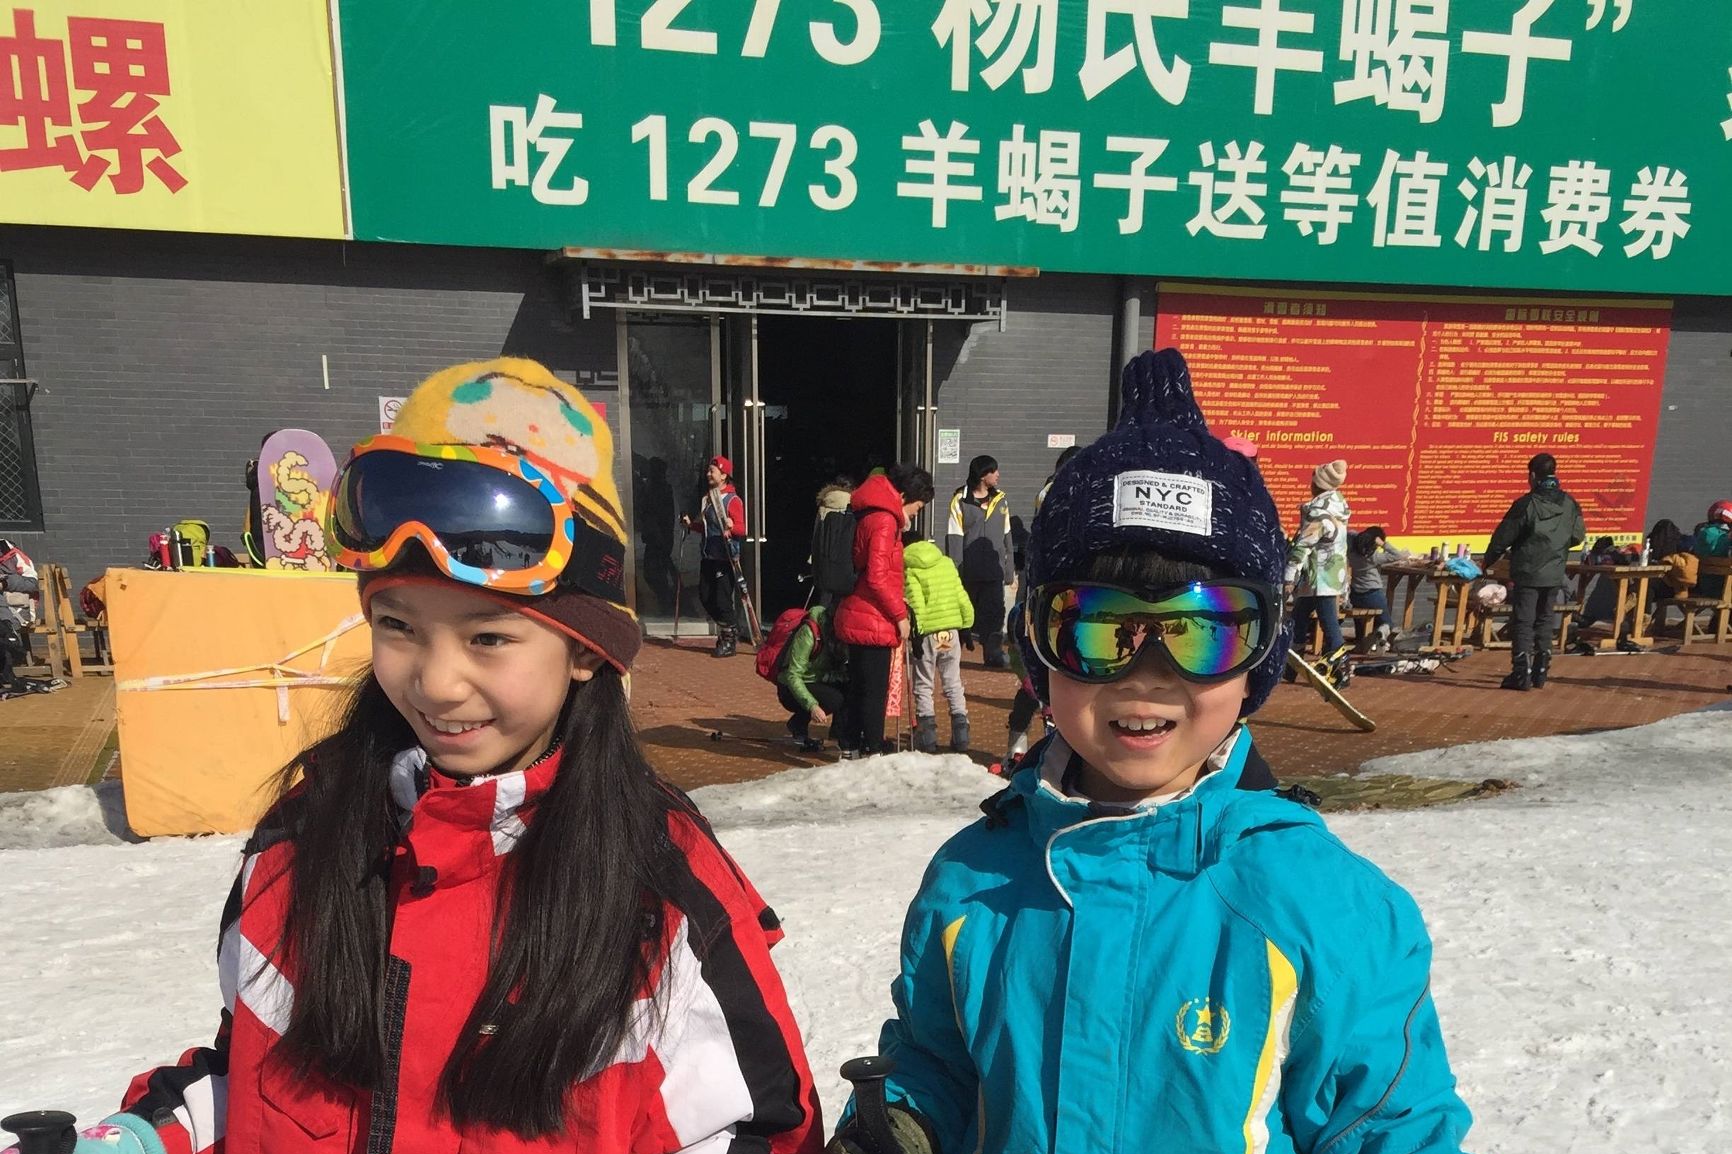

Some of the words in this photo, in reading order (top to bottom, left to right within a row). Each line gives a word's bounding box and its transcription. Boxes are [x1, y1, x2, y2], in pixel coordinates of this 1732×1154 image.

[0, 8, 189, 195] 螺
[489, 93, 589, 206] 吃
[631, 114, 858, 211] 1273
[896, 119, 1693, 260] 羊蝎子送等值消费券
[1266, 430, 1334, 442] information
[1493, 432, 1509, 443] FIS
[1513, 432, 1549, 444] safety
[1552, 432, 1580, 443] rules
[1122, 479, 1160, 487] DESIGNED
[1169, 483, 1205, 495] CRAFTED
[1135, 486, 1193, 505] NYC
[1139, 500, 1188, 513] STANDARD
